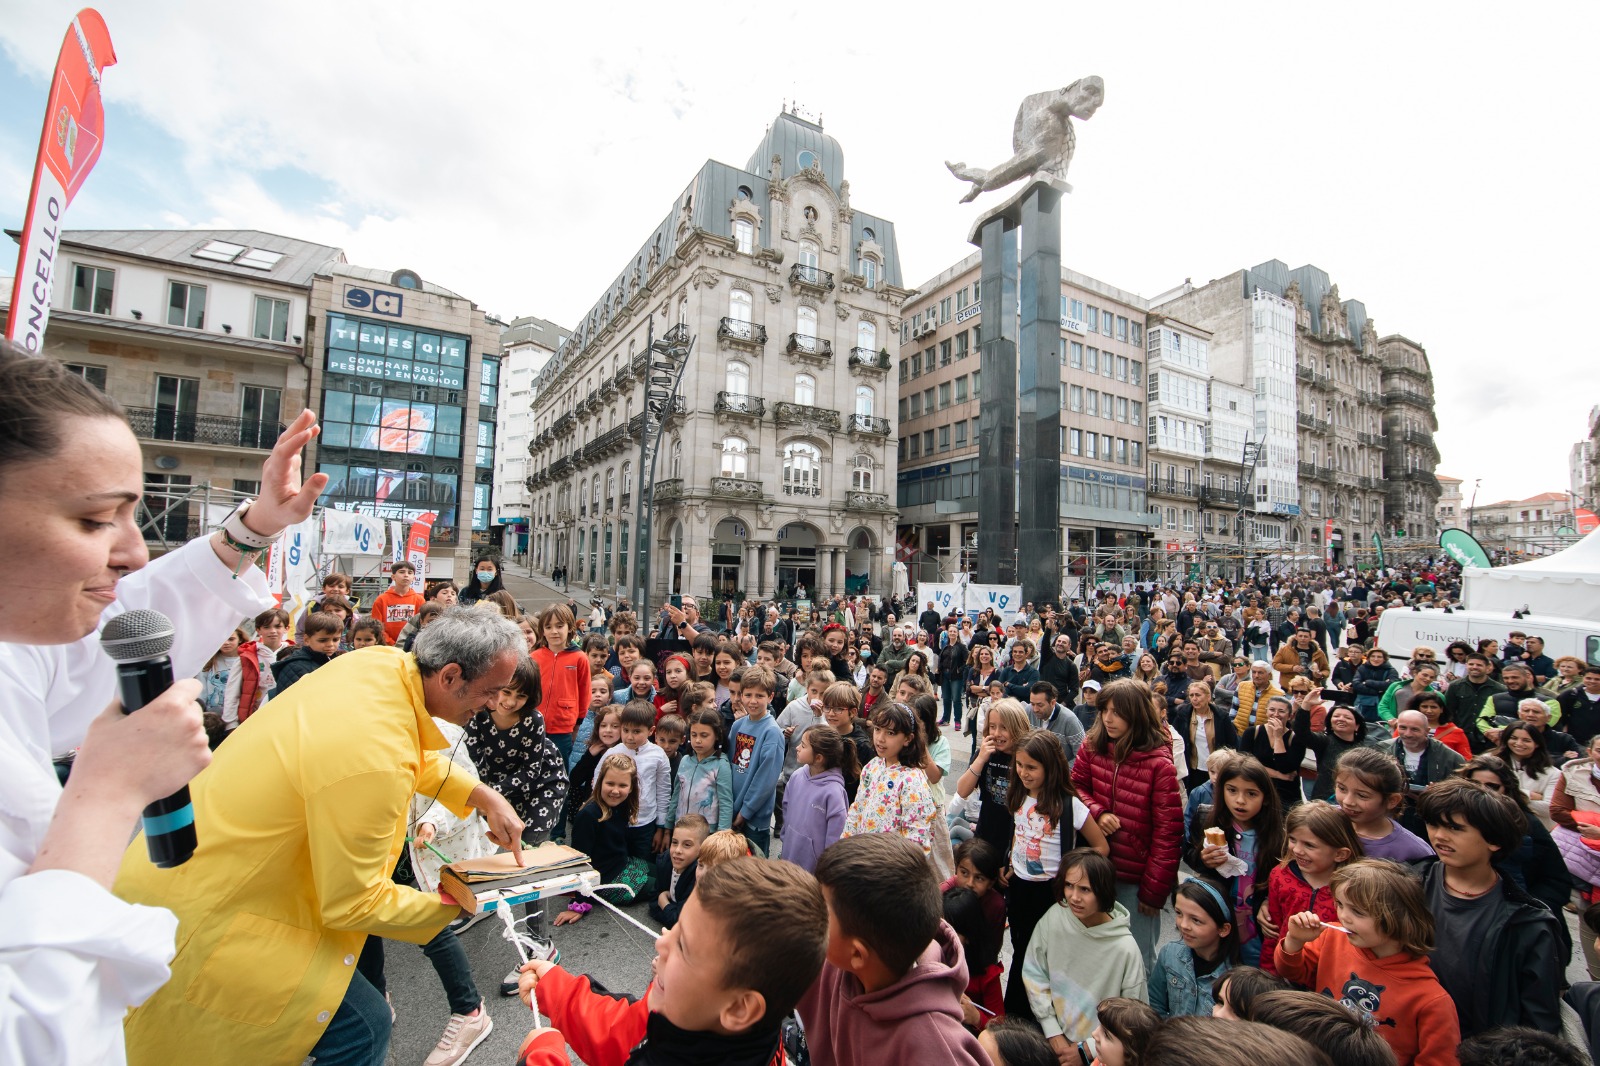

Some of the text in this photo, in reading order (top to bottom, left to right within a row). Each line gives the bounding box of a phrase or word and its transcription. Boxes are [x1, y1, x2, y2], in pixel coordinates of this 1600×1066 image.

[25, 196, 60, 352] ONCELLO
[964, 304, 982, 318] EUDI
[1061, 319, 1080, 331] DITEC
[336, 328, 460, 357] TIENES QUE
[331, 361, 459, 386] PESCADO ENVASADO
[348, 356, 445, 376] COMPRAR SOLO
[416, 559, 424, 575] VIGO
[1415, 630, 1482, 646] Universid
